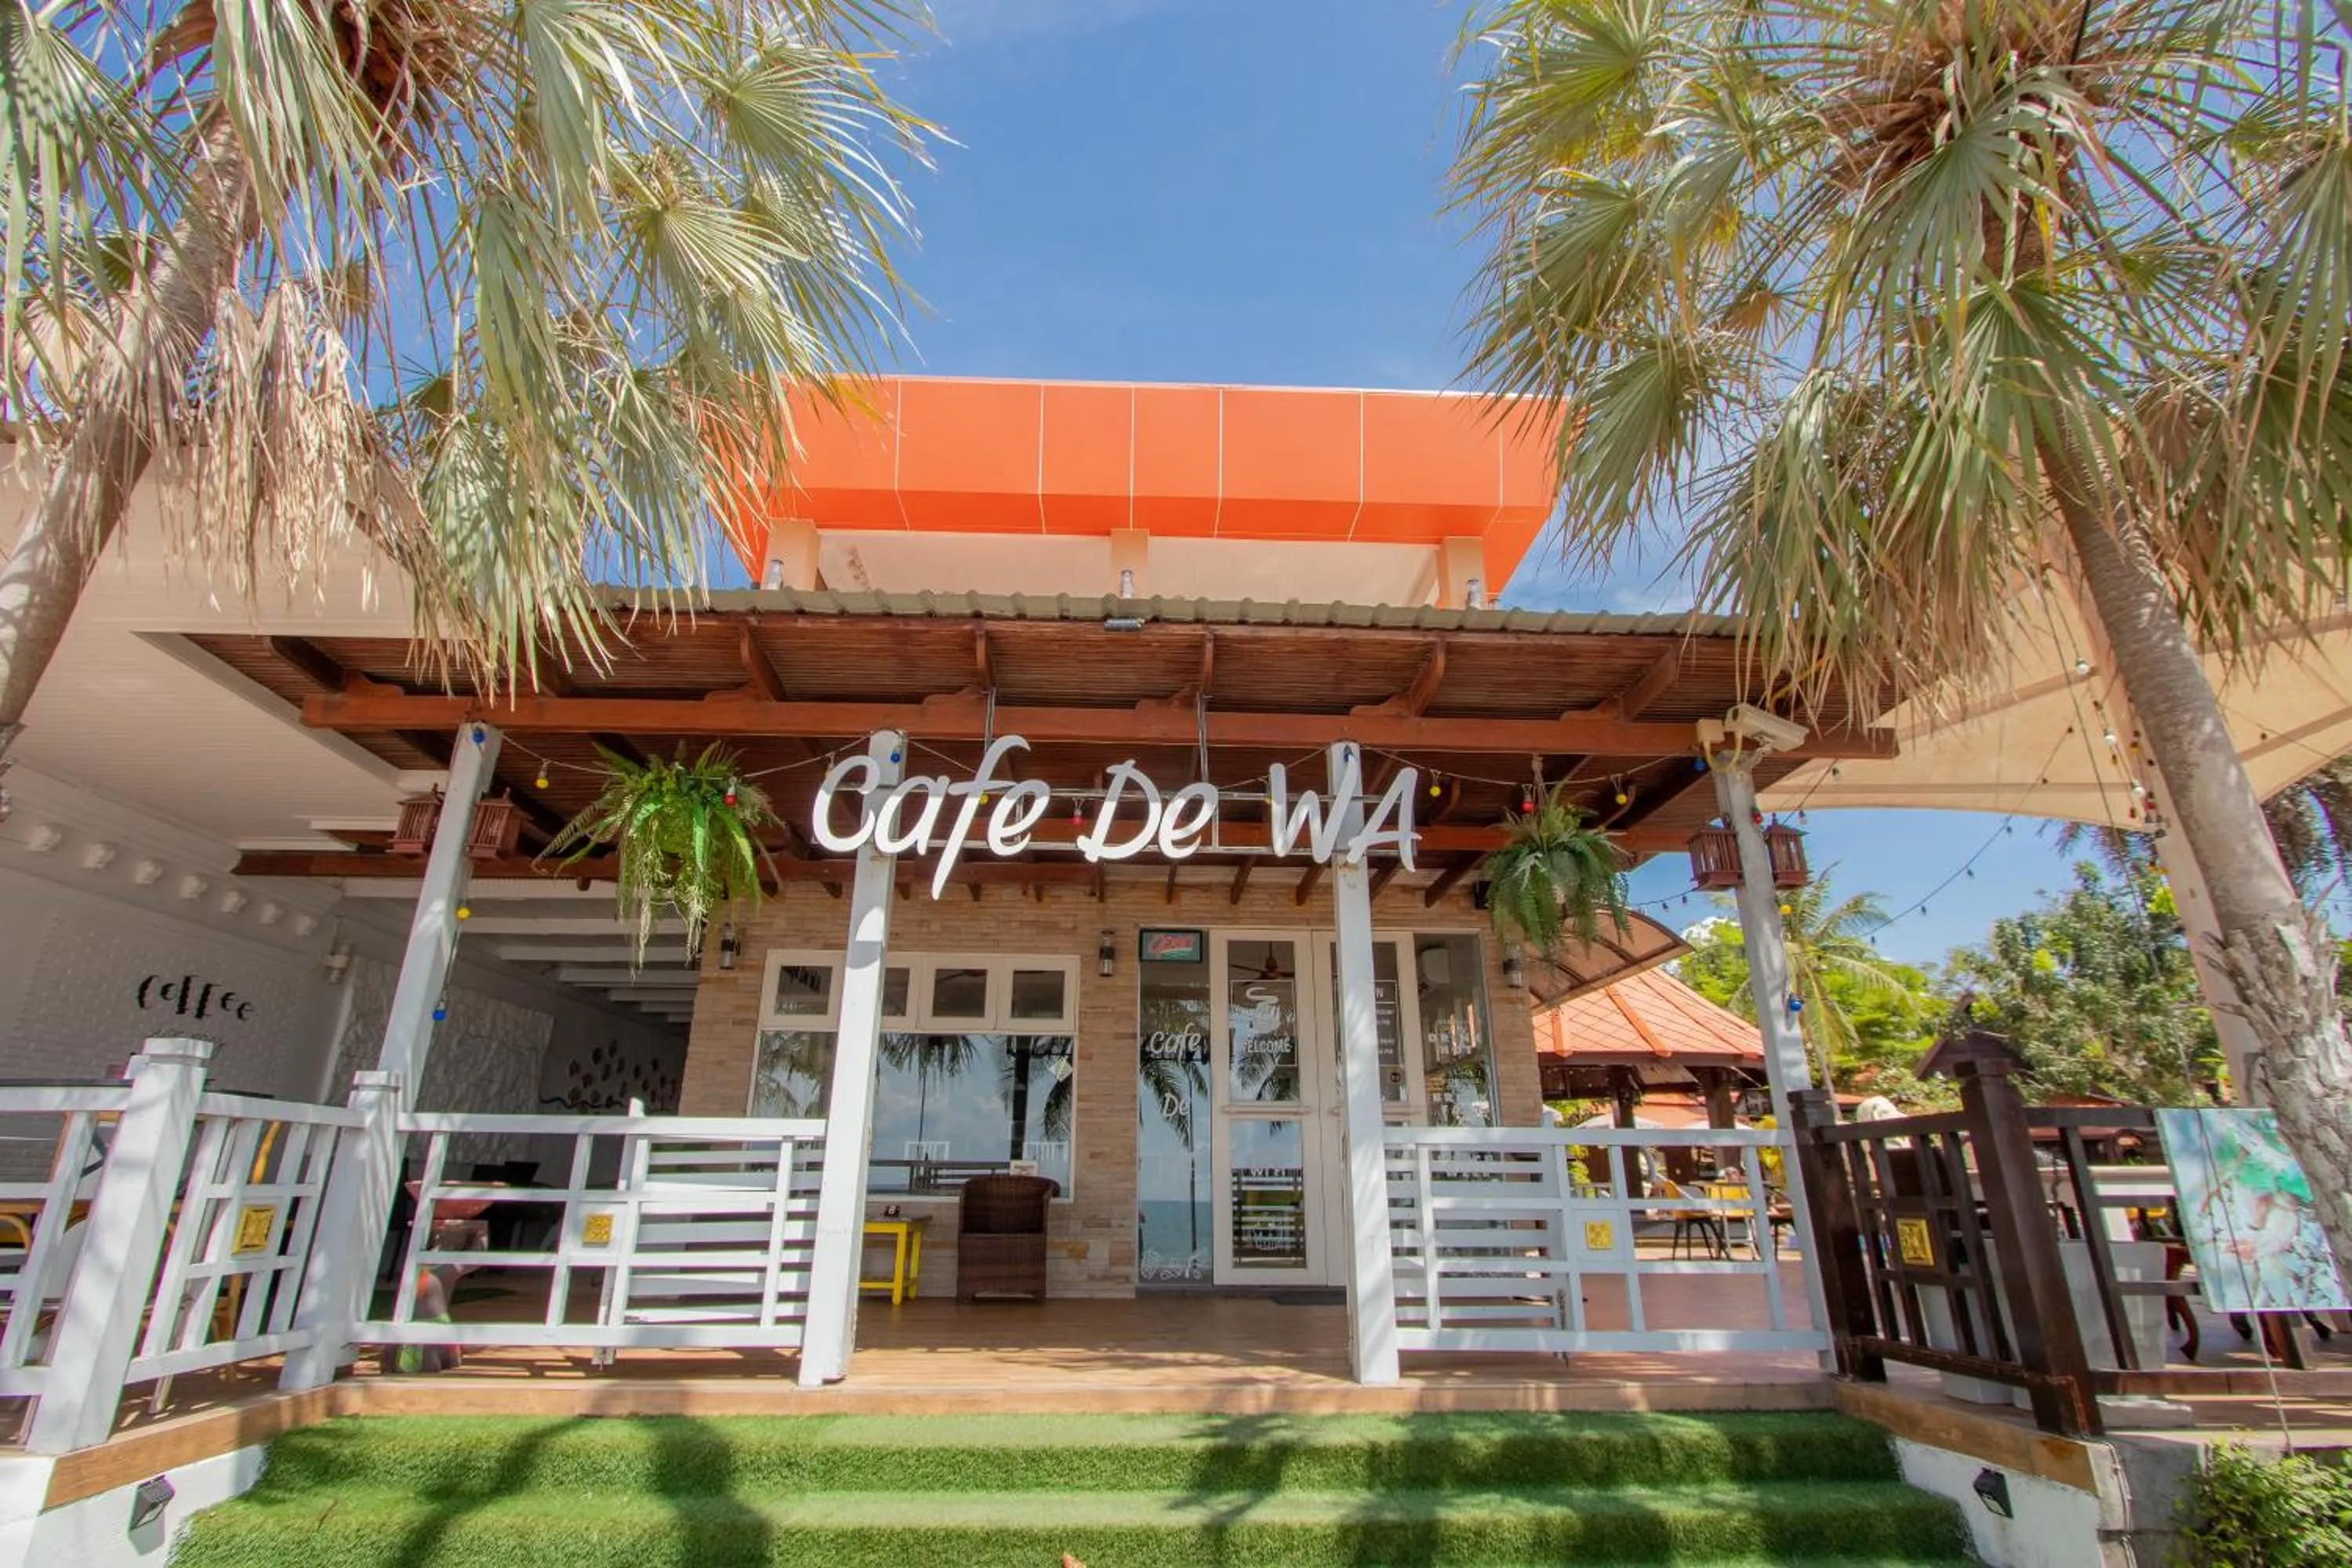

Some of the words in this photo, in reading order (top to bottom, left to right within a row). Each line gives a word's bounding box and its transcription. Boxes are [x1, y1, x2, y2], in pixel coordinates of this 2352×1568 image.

[811, 735, 1051, 901] Cafe
[1076, 758, 1219, 863] De
[1270, 754, 1422, 873] WA
[1150, 1022, 1201, 1066] Cafe
[1162, 1092, 1190, 1116] De
